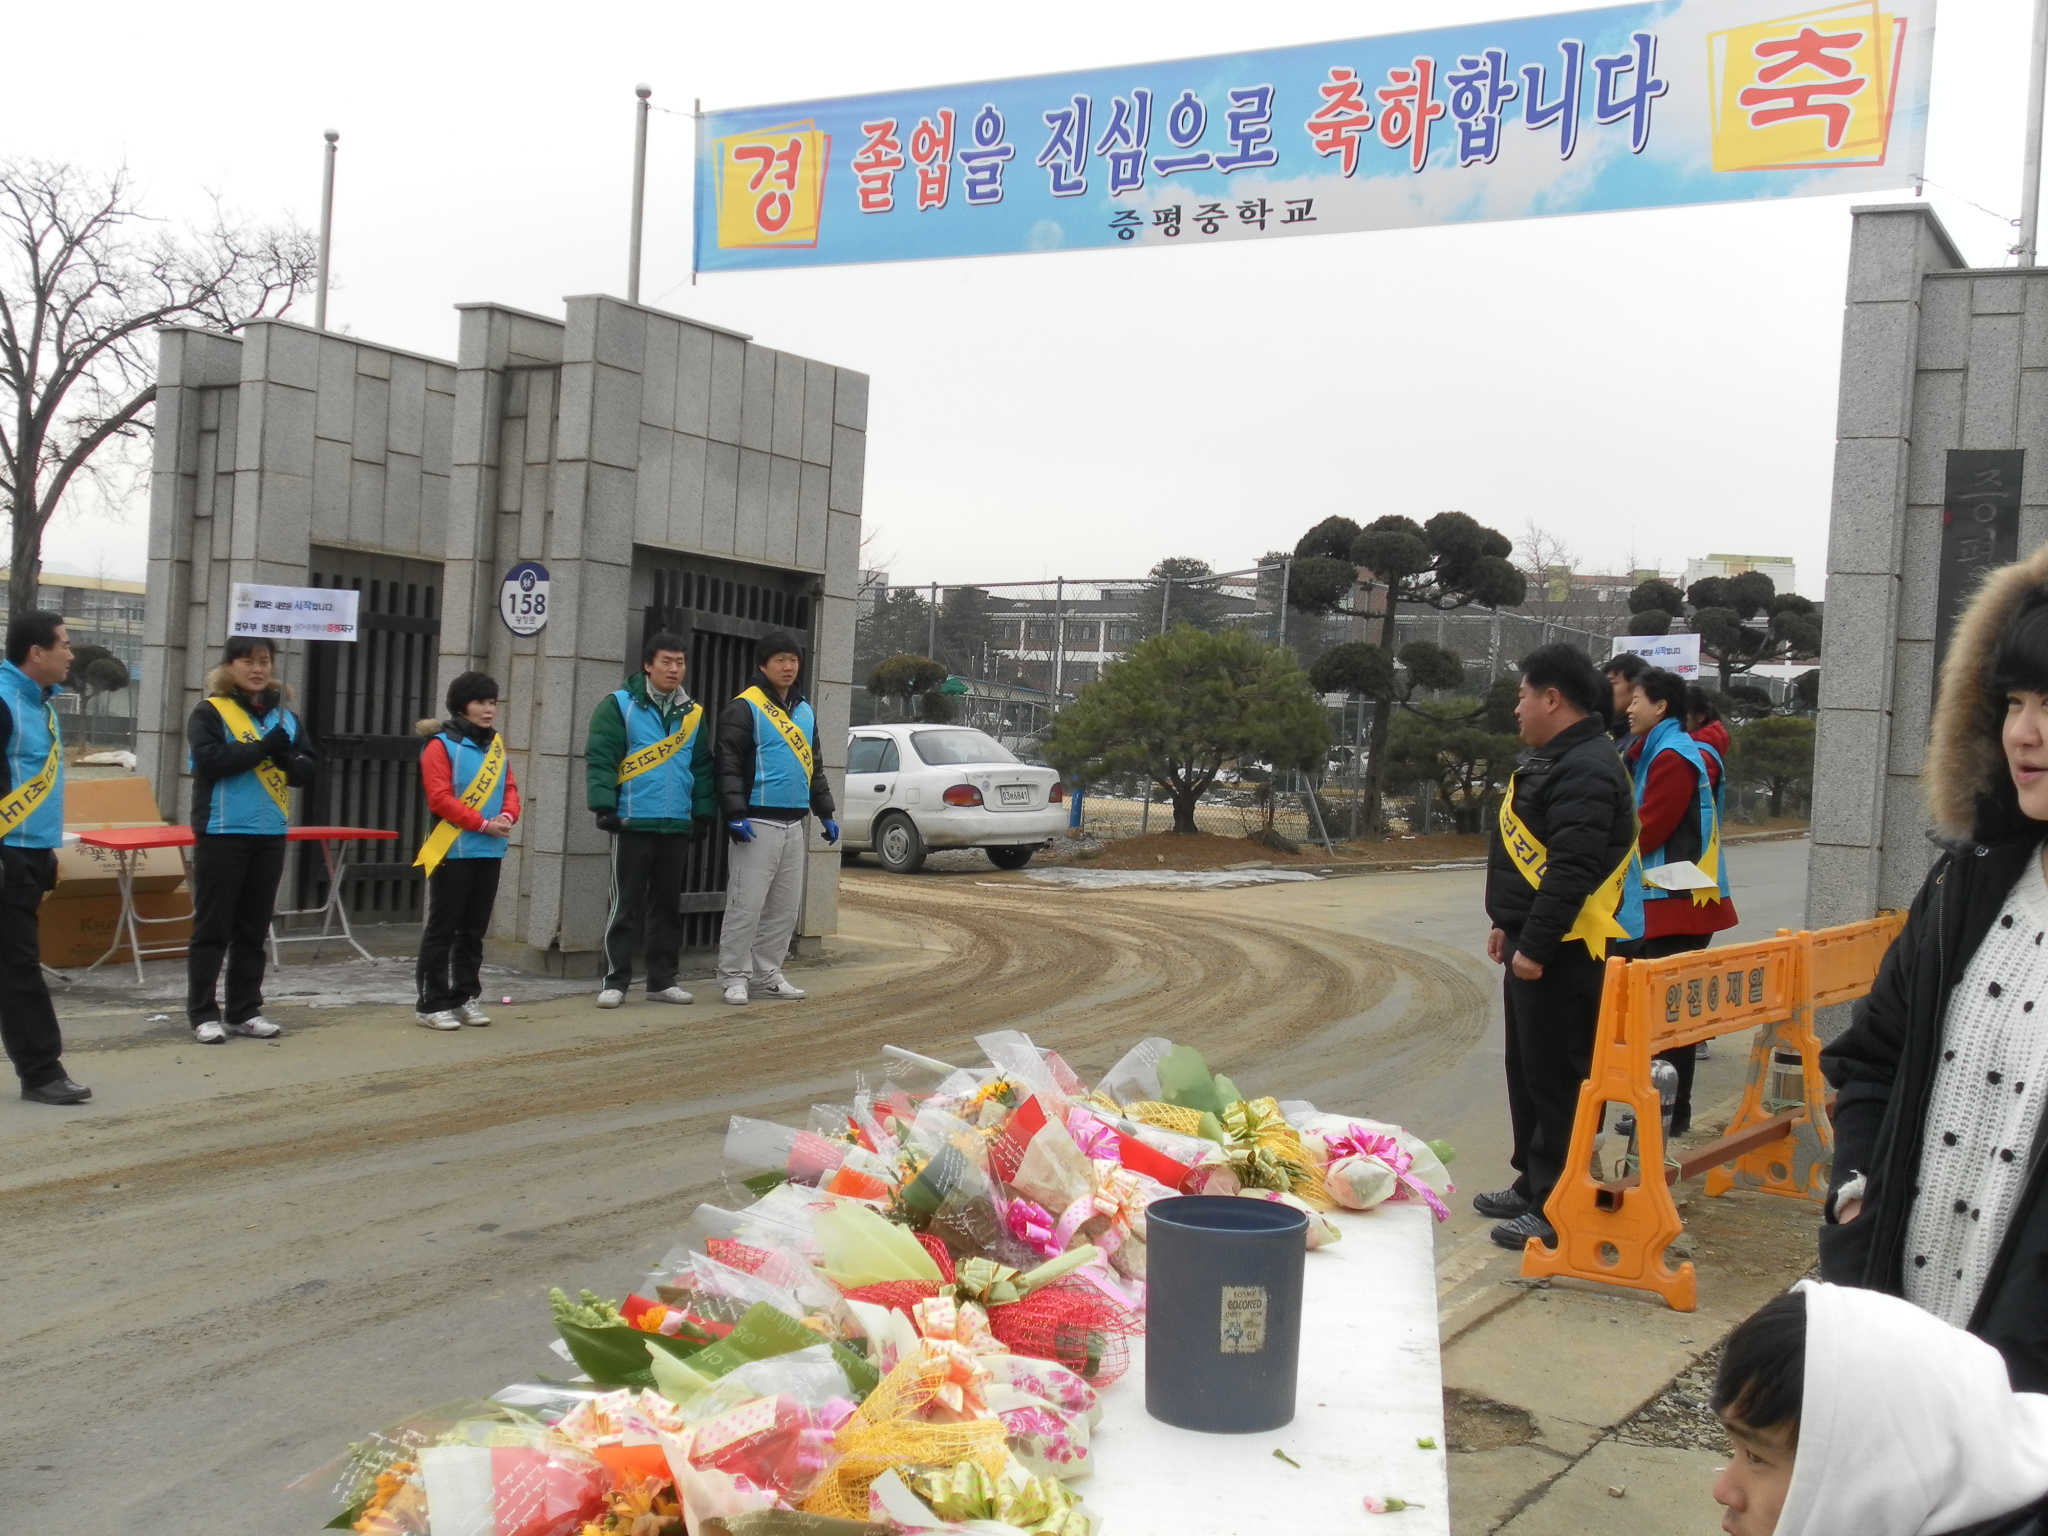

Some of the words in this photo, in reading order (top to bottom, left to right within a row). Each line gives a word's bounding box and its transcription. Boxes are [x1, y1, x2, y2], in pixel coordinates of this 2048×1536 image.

[853, 104, 1013, 211] 졸업을
[1038, 84, 1278, 195] 진심으로
[1306, 32, 1667, 176] 축하합니다
[1739, 27, 1865, 151] 축
[733, 137, 804, 235] 경
[1107, 198, 1318, 241] 증평중학교
[508, 593, 546, 615] 158
